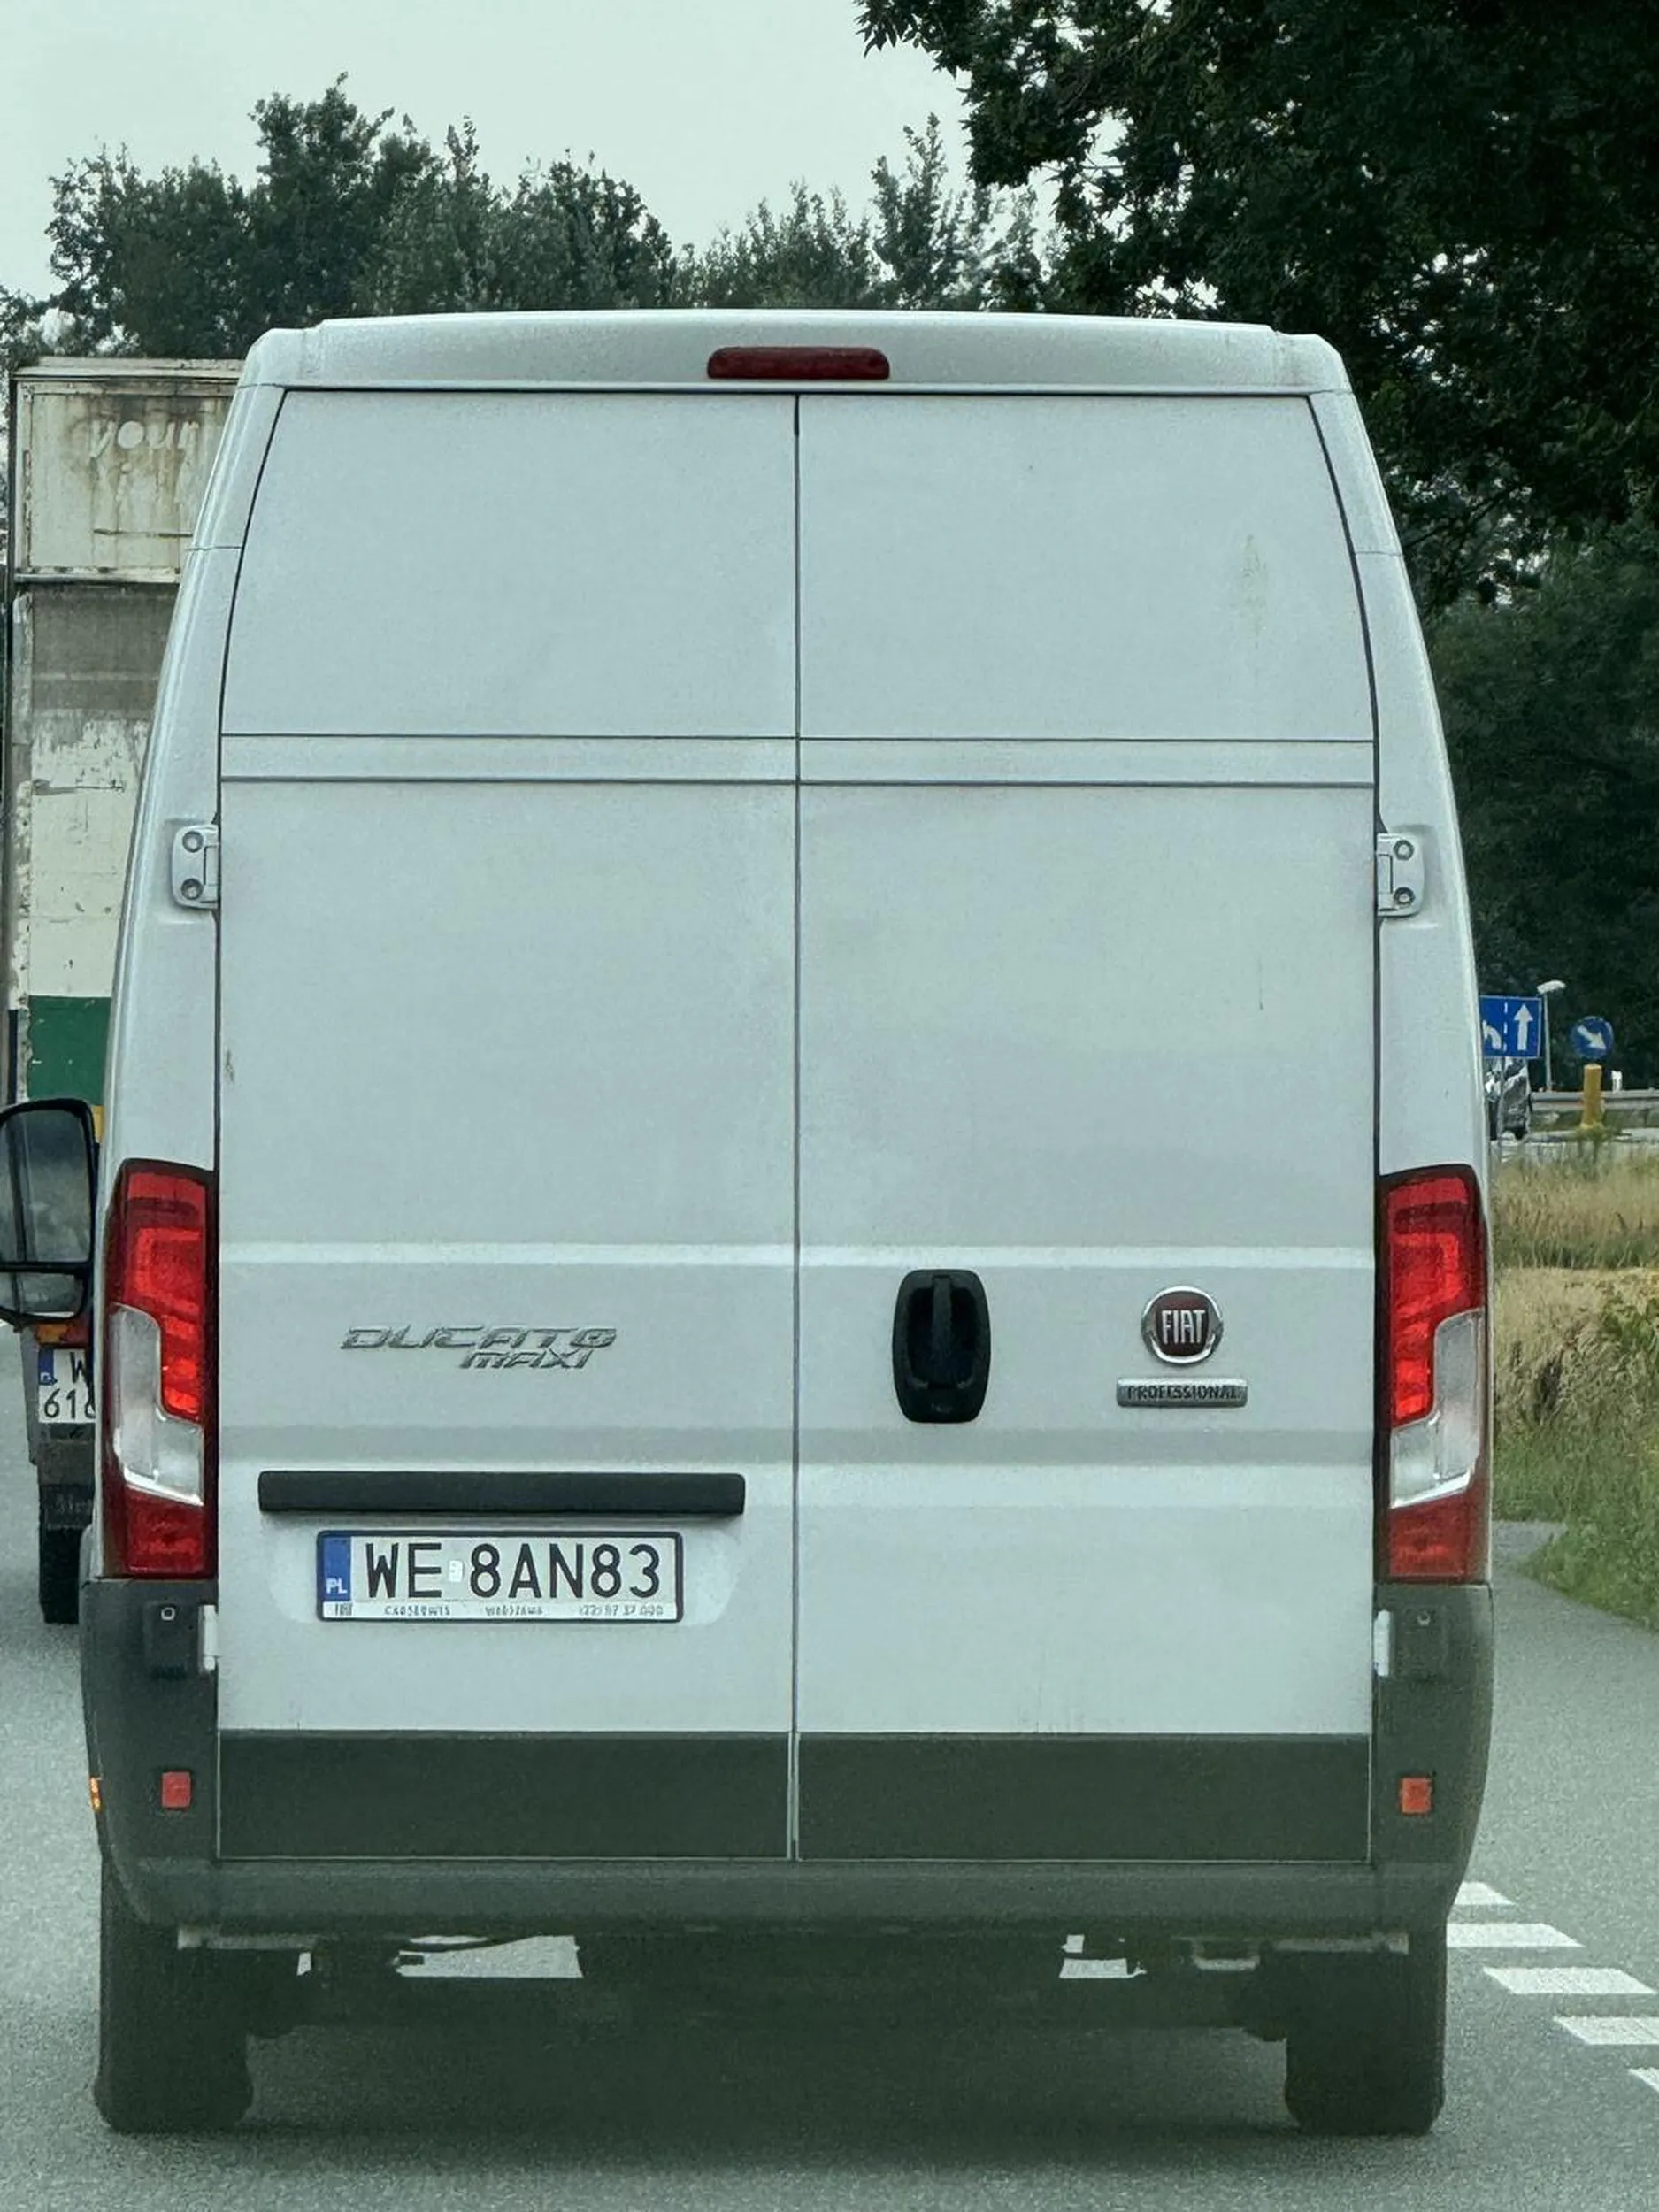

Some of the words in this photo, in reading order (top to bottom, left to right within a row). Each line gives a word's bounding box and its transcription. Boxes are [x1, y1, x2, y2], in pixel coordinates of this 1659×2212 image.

[340, 1324, 617, 1349] DUCATO
[1162, 1310, 1206, 1344] FIAT
[458, 1348, 594, 1369] MAXI
[1127, 1385, 1238, 1400] PROFESSIONAL
[365, 1542, 442, 1598] WE
[470, 1542, 660, 1598] 8AN83
[326, 1578, 348, 1594] PL
